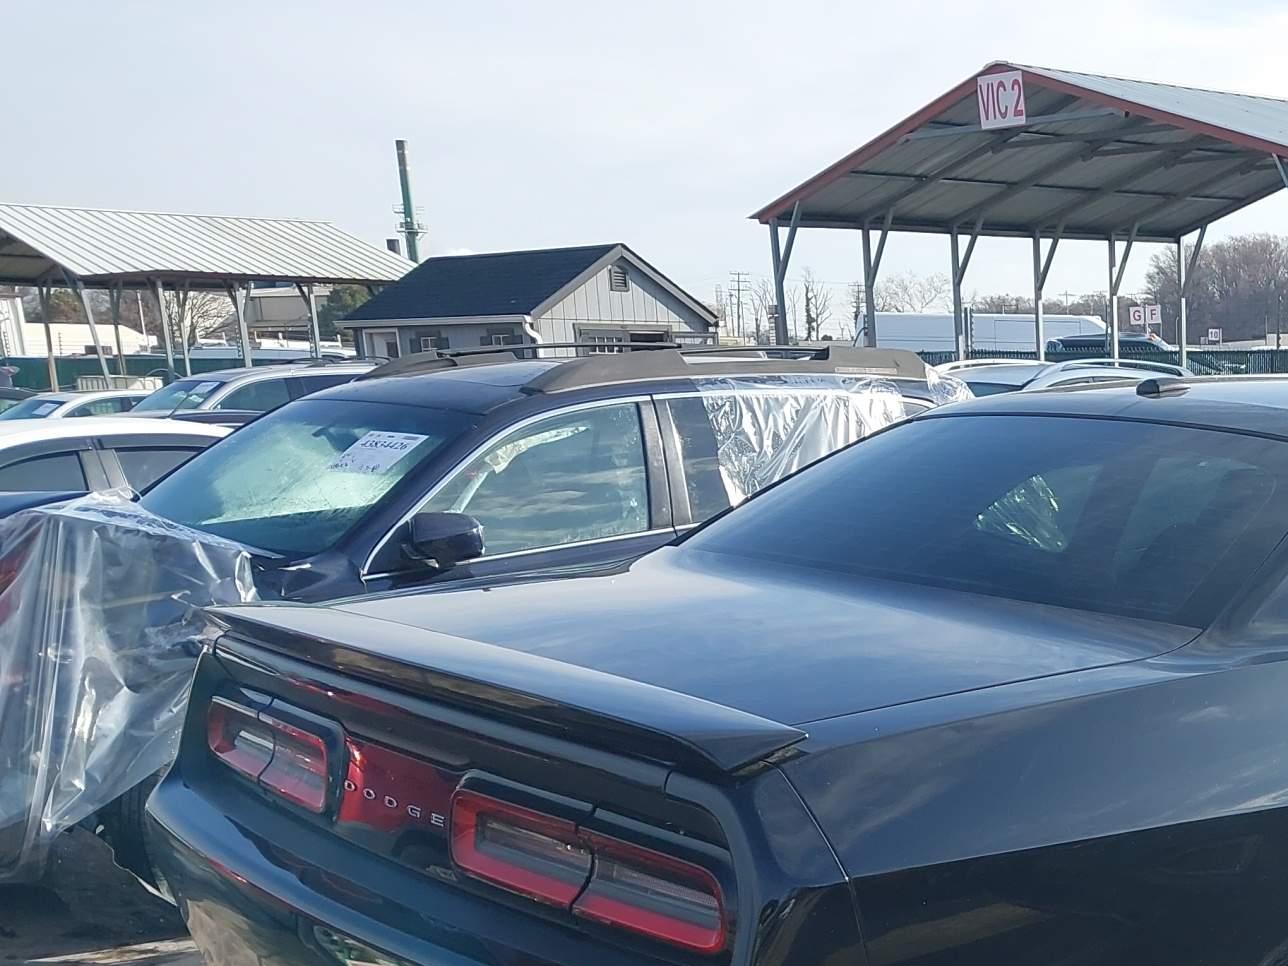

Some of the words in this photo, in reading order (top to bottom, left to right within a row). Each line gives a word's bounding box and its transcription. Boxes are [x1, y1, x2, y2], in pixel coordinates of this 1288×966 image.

[979, 80, 1008, 120] VIC
[1011, 79, 1024, 117] 2
[1133, 310, 1142, 321] G
[1150, 309, 1157, 321] F
[344, 780, 445, 827] DODGE
